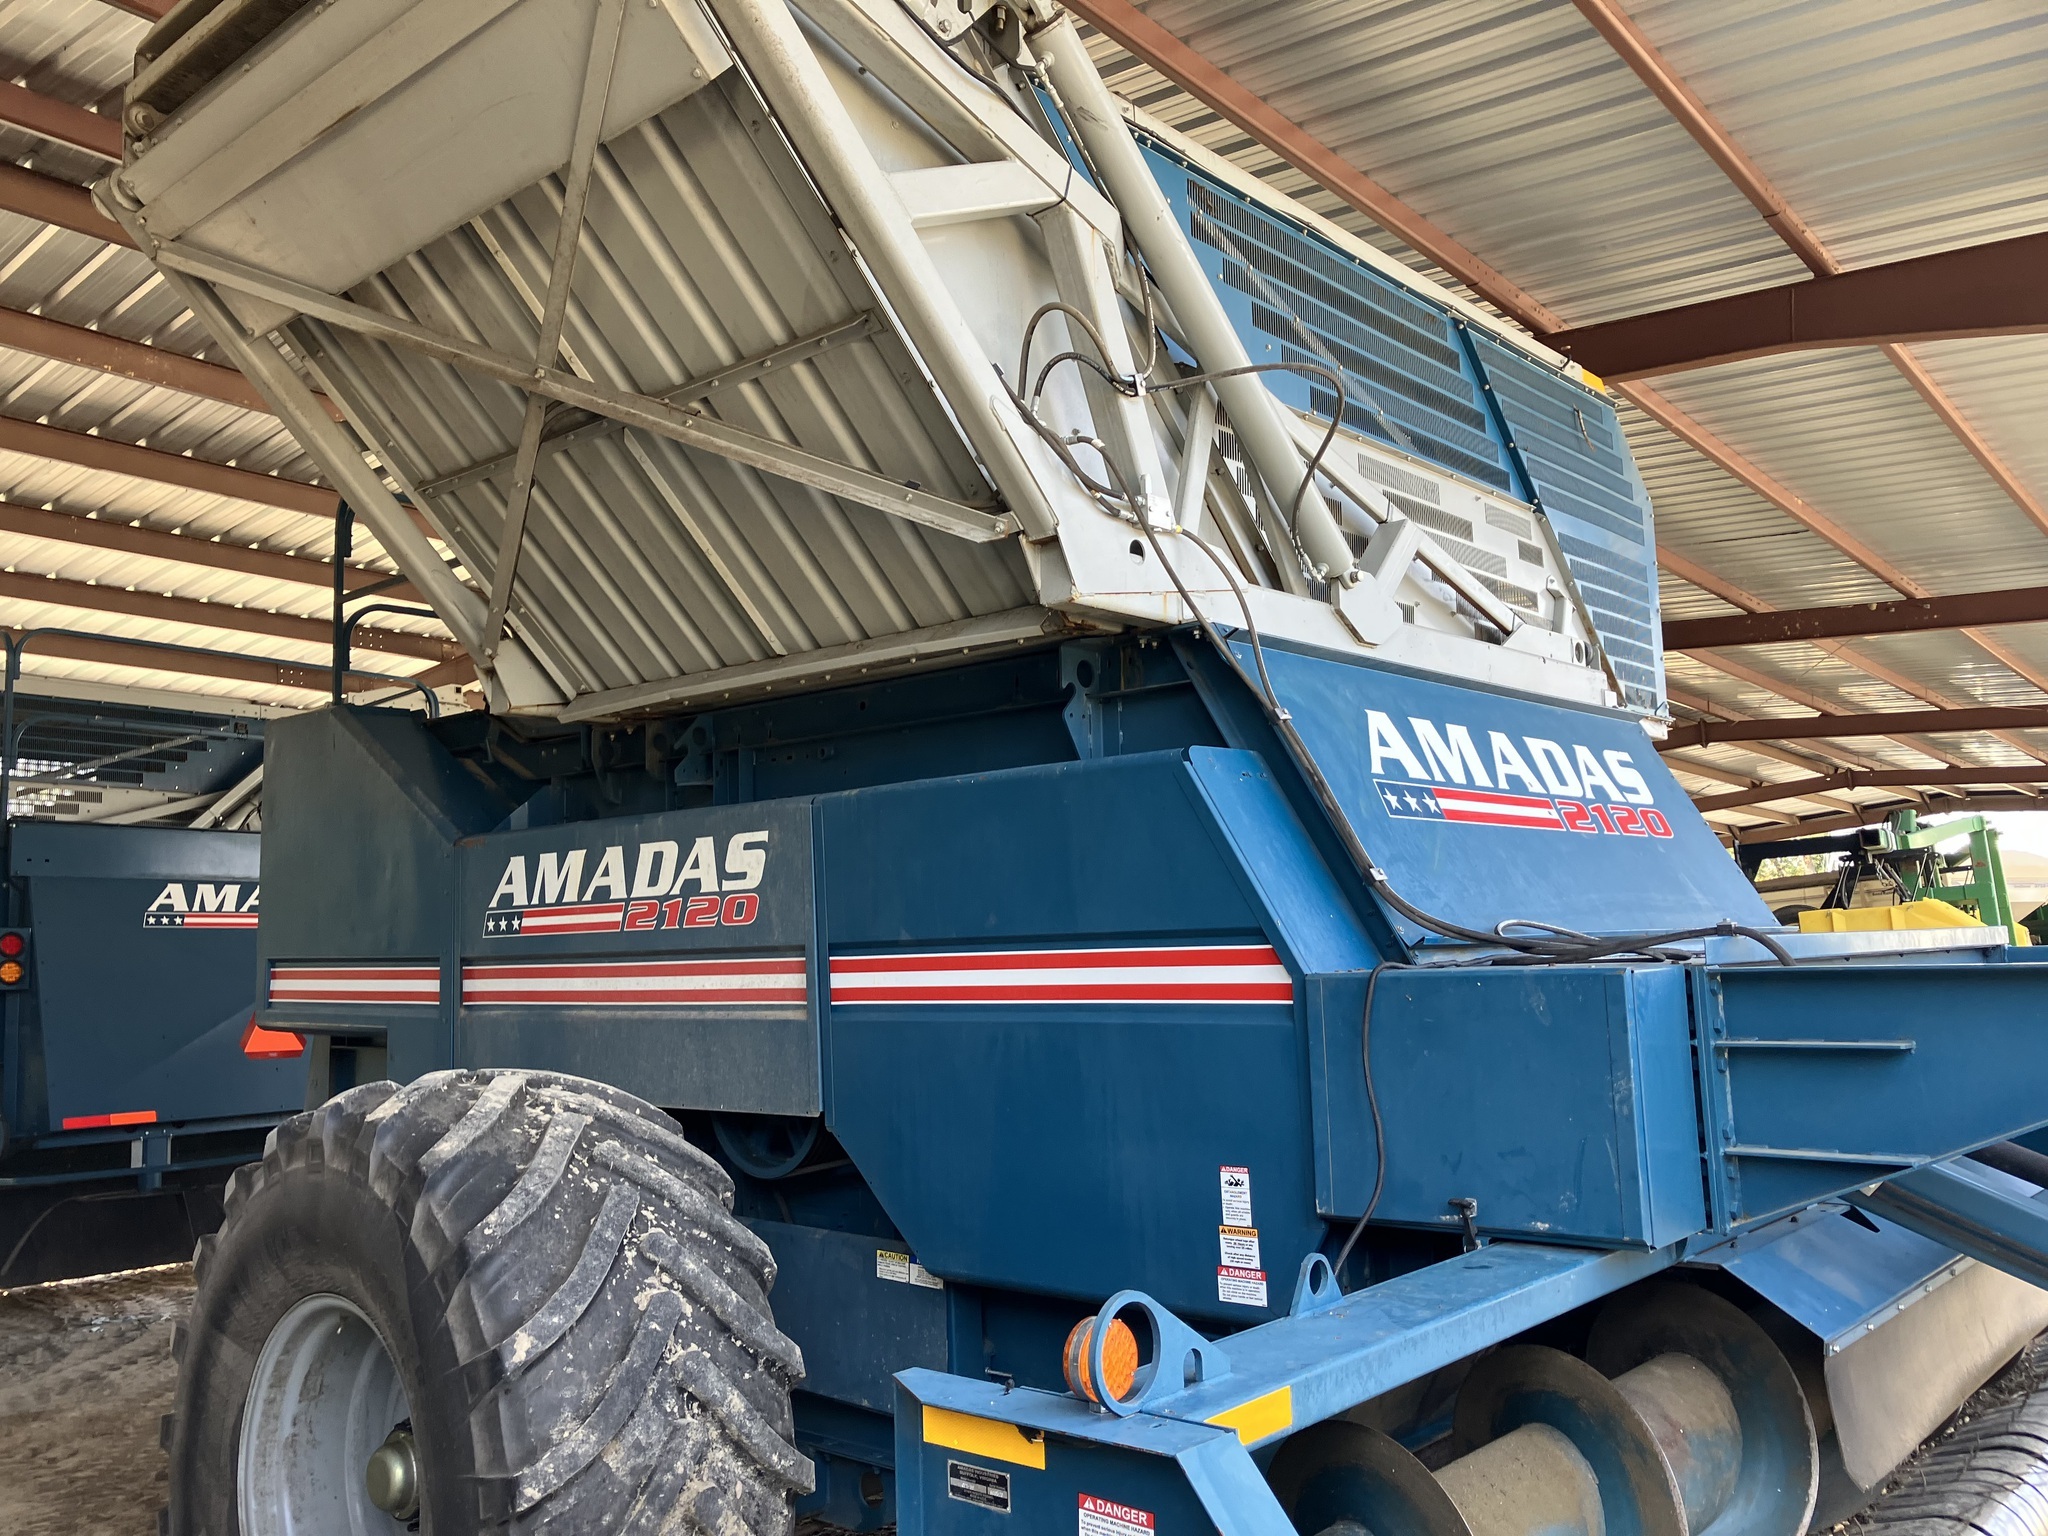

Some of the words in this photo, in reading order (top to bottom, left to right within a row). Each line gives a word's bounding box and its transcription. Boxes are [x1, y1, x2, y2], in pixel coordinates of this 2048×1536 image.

[1364, 709, 1654, 805] AMADAS
[1554, 798, 1674, 839] 2120
[488, 830, 769, 908] AMADAS
[623, 893, 760, 932] 2120
[1227, 1228, 1257, 1237] WARNING
[884, 1252, 908, 1262] CAUTION
[1228, 1268, 1262, 1280] DANGER
[1083, 1512, 1109, 1524] OPERATING
[1109, 1519, 1130, 1530] MACHINE
[1131, 1526, 1151, 1536] HAZARD
[1097, 1499, 1147, 1526] DANGER
